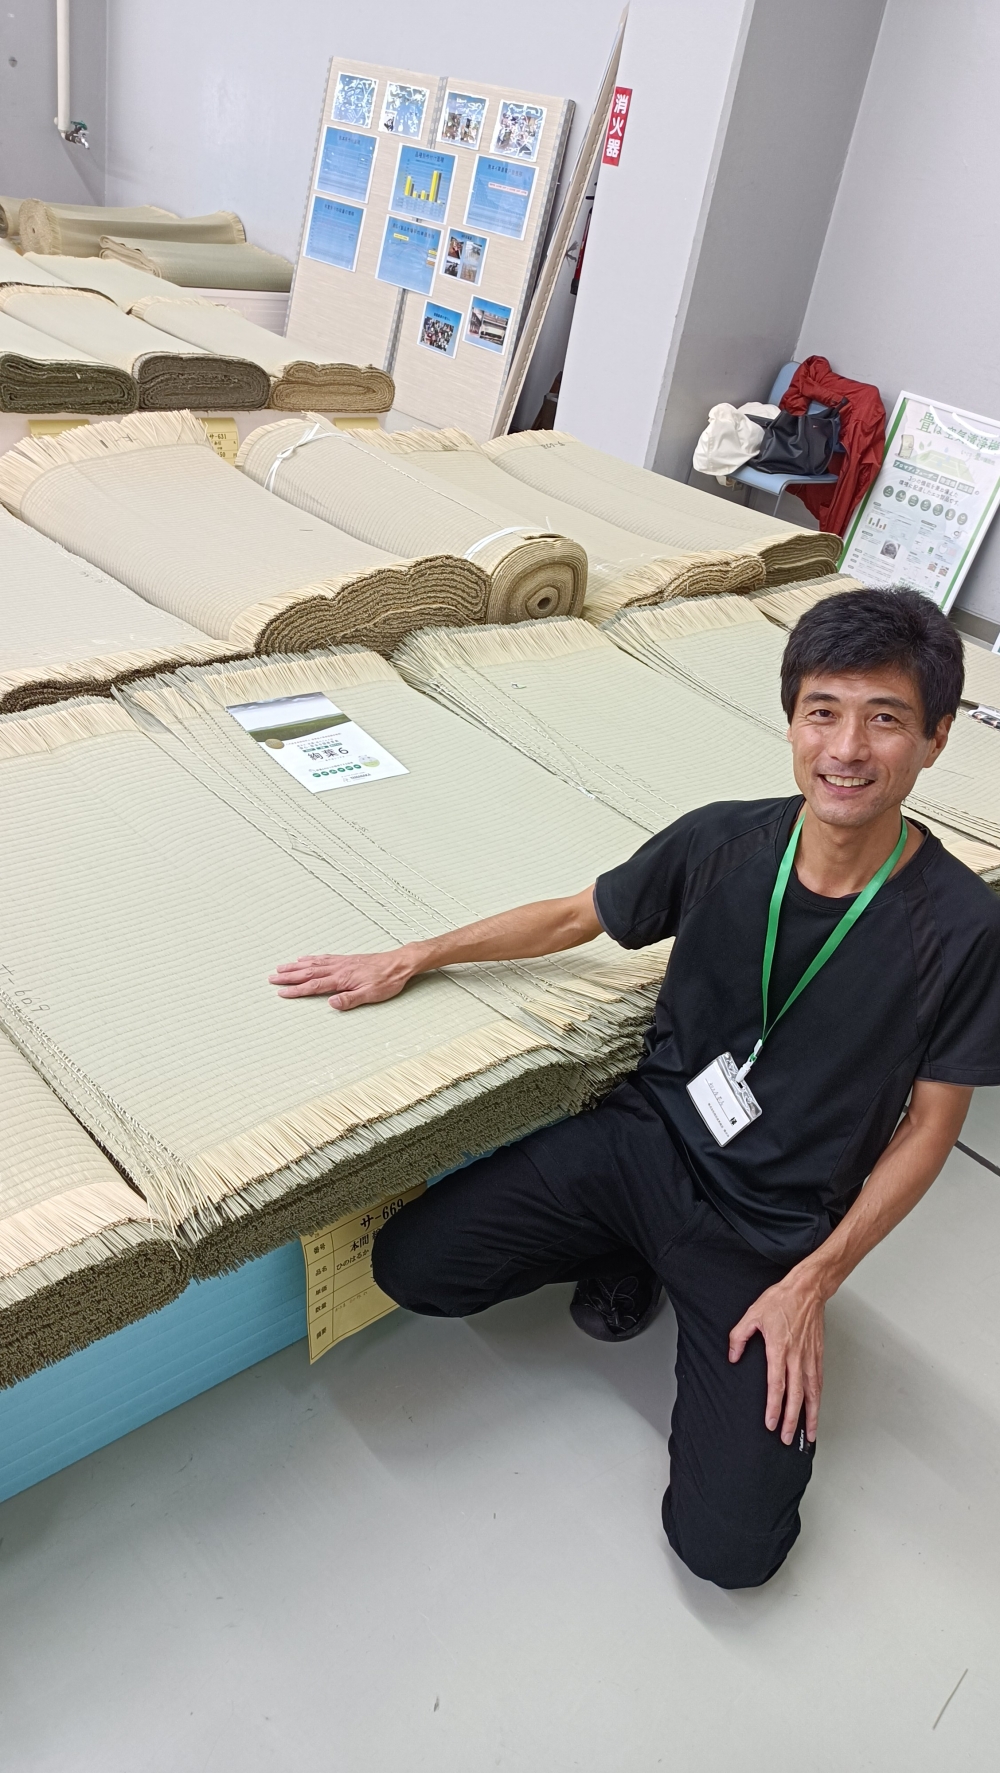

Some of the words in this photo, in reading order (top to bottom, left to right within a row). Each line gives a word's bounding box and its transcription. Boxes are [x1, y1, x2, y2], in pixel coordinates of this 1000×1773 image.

[605, 93, 630, 158] 消火器
[313, 1242, 326, 1255] 番号
[350, 1234, 370, 1252] 本間
[336, 1249, 370, 1271] ひのはるか
[315, 1265, 328, 1277] 品名
[315, 1284, 328, 1296] 単価
[315, 1301, 327, 1314] 数量
